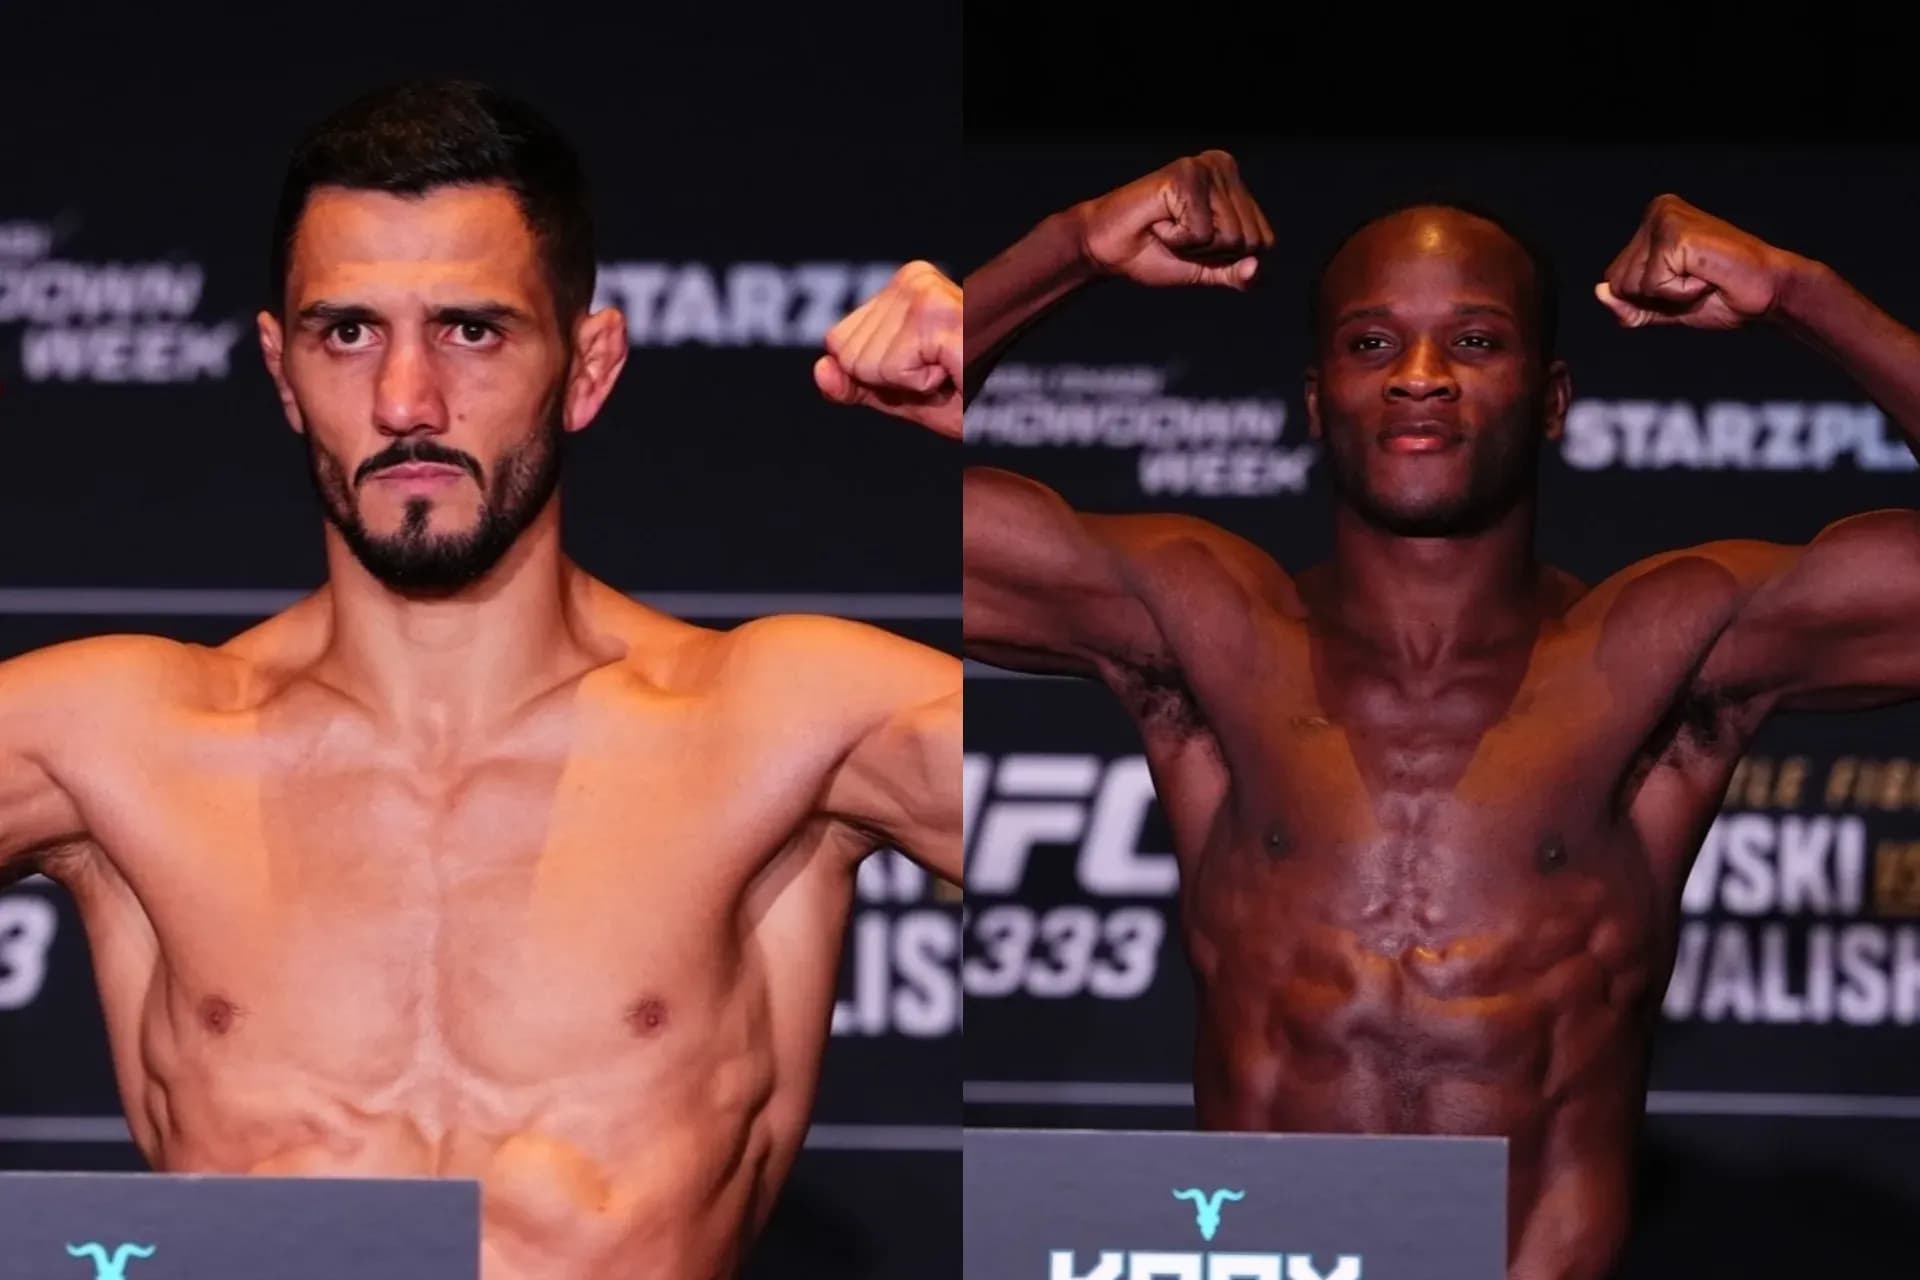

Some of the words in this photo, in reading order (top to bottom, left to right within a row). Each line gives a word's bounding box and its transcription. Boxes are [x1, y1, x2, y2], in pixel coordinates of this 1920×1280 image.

[591, 260, 902, 346] TARZ
[23, 322, 240, 382] WEEK
[1140, 449, 1314, 494] WEEK
[963, 905, 1165, 998] 333
